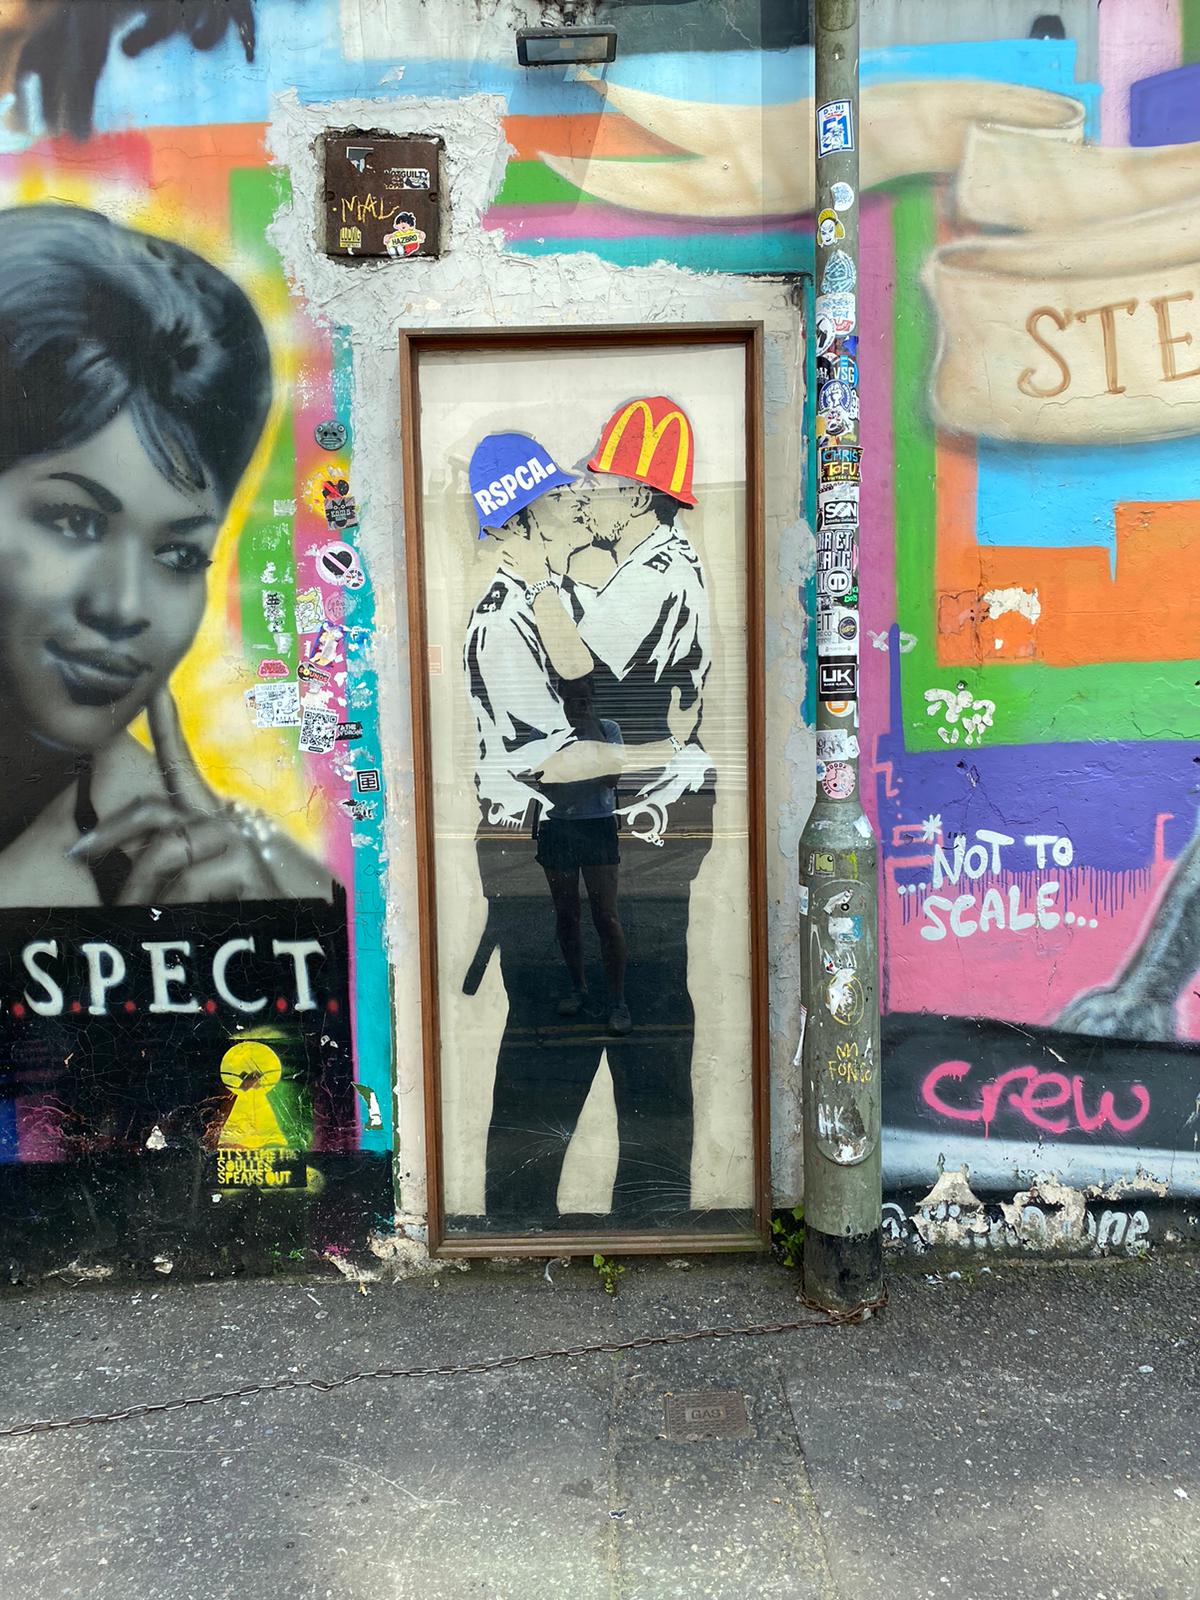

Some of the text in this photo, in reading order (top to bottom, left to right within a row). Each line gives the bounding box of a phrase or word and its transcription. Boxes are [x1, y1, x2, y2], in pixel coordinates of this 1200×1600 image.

[822, 450, 859, 462] CHRIS
[1024, 834, 1074, 869] TO
[265, 1171, 292, 1185] OUT
[691, 1408, 722, 1420] GAS
